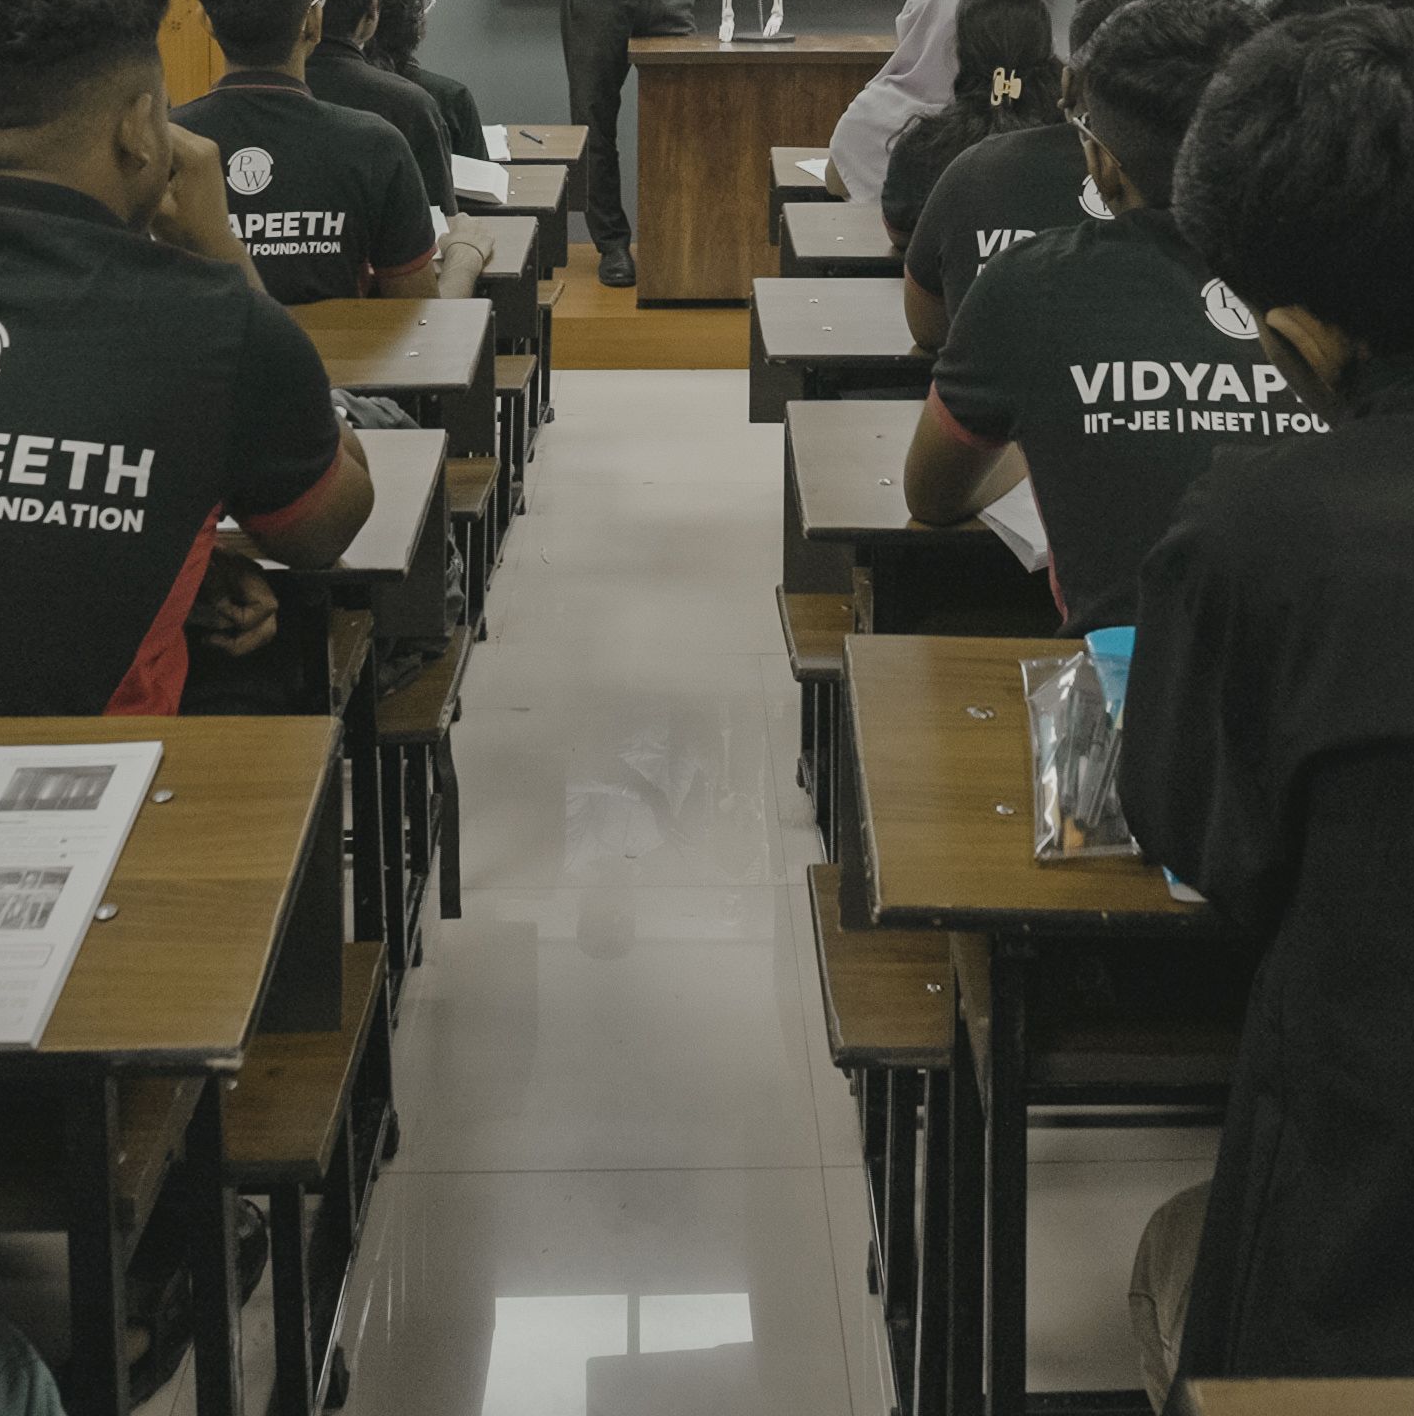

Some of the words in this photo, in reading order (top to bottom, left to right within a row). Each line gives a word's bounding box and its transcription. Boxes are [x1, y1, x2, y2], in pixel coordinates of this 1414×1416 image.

[253, 241, 341, 256] FOUNDATION
[1069, 361, 1302, 404] VIDYAP
[1083, 409, 1170, 434] IIT-JEE
[1191, 410, 1255, 431] NEET
